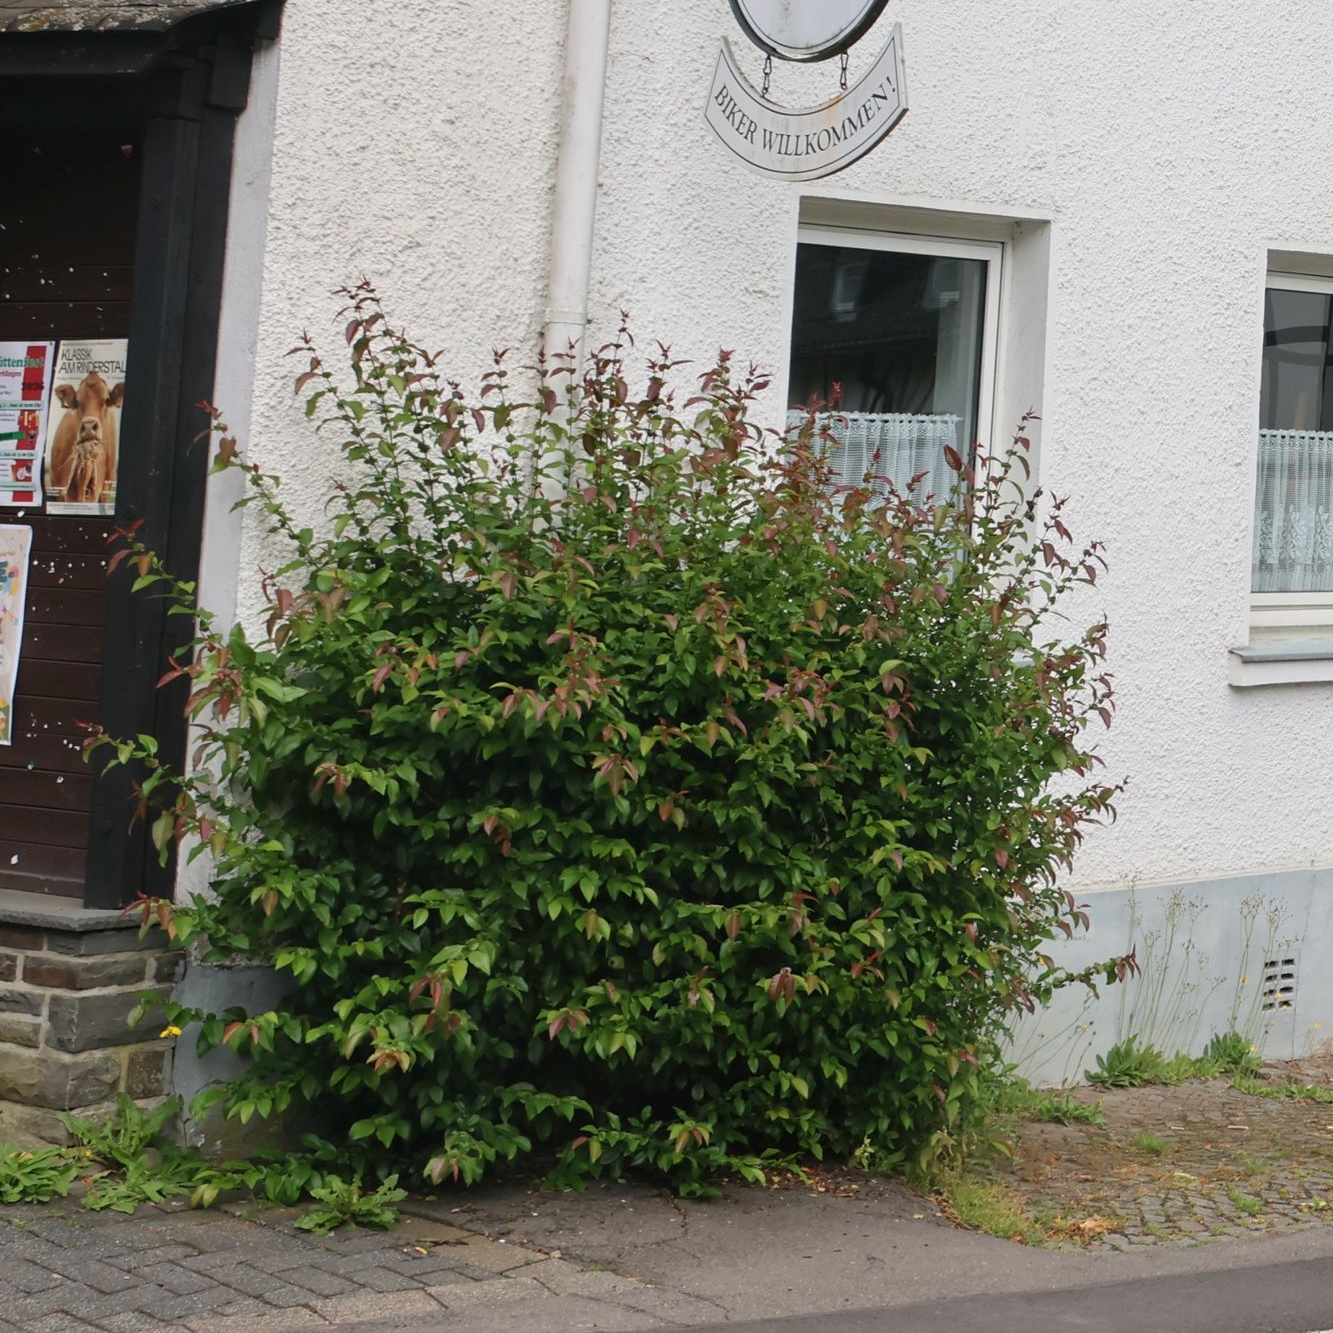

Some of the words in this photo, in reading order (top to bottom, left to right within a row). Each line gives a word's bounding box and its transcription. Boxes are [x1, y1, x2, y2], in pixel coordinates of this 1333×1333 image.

[715, 83, 757, 144] BIKER
[61, 348, 92, 361] KLASSIK
[58, 362, 75, 374] AM
